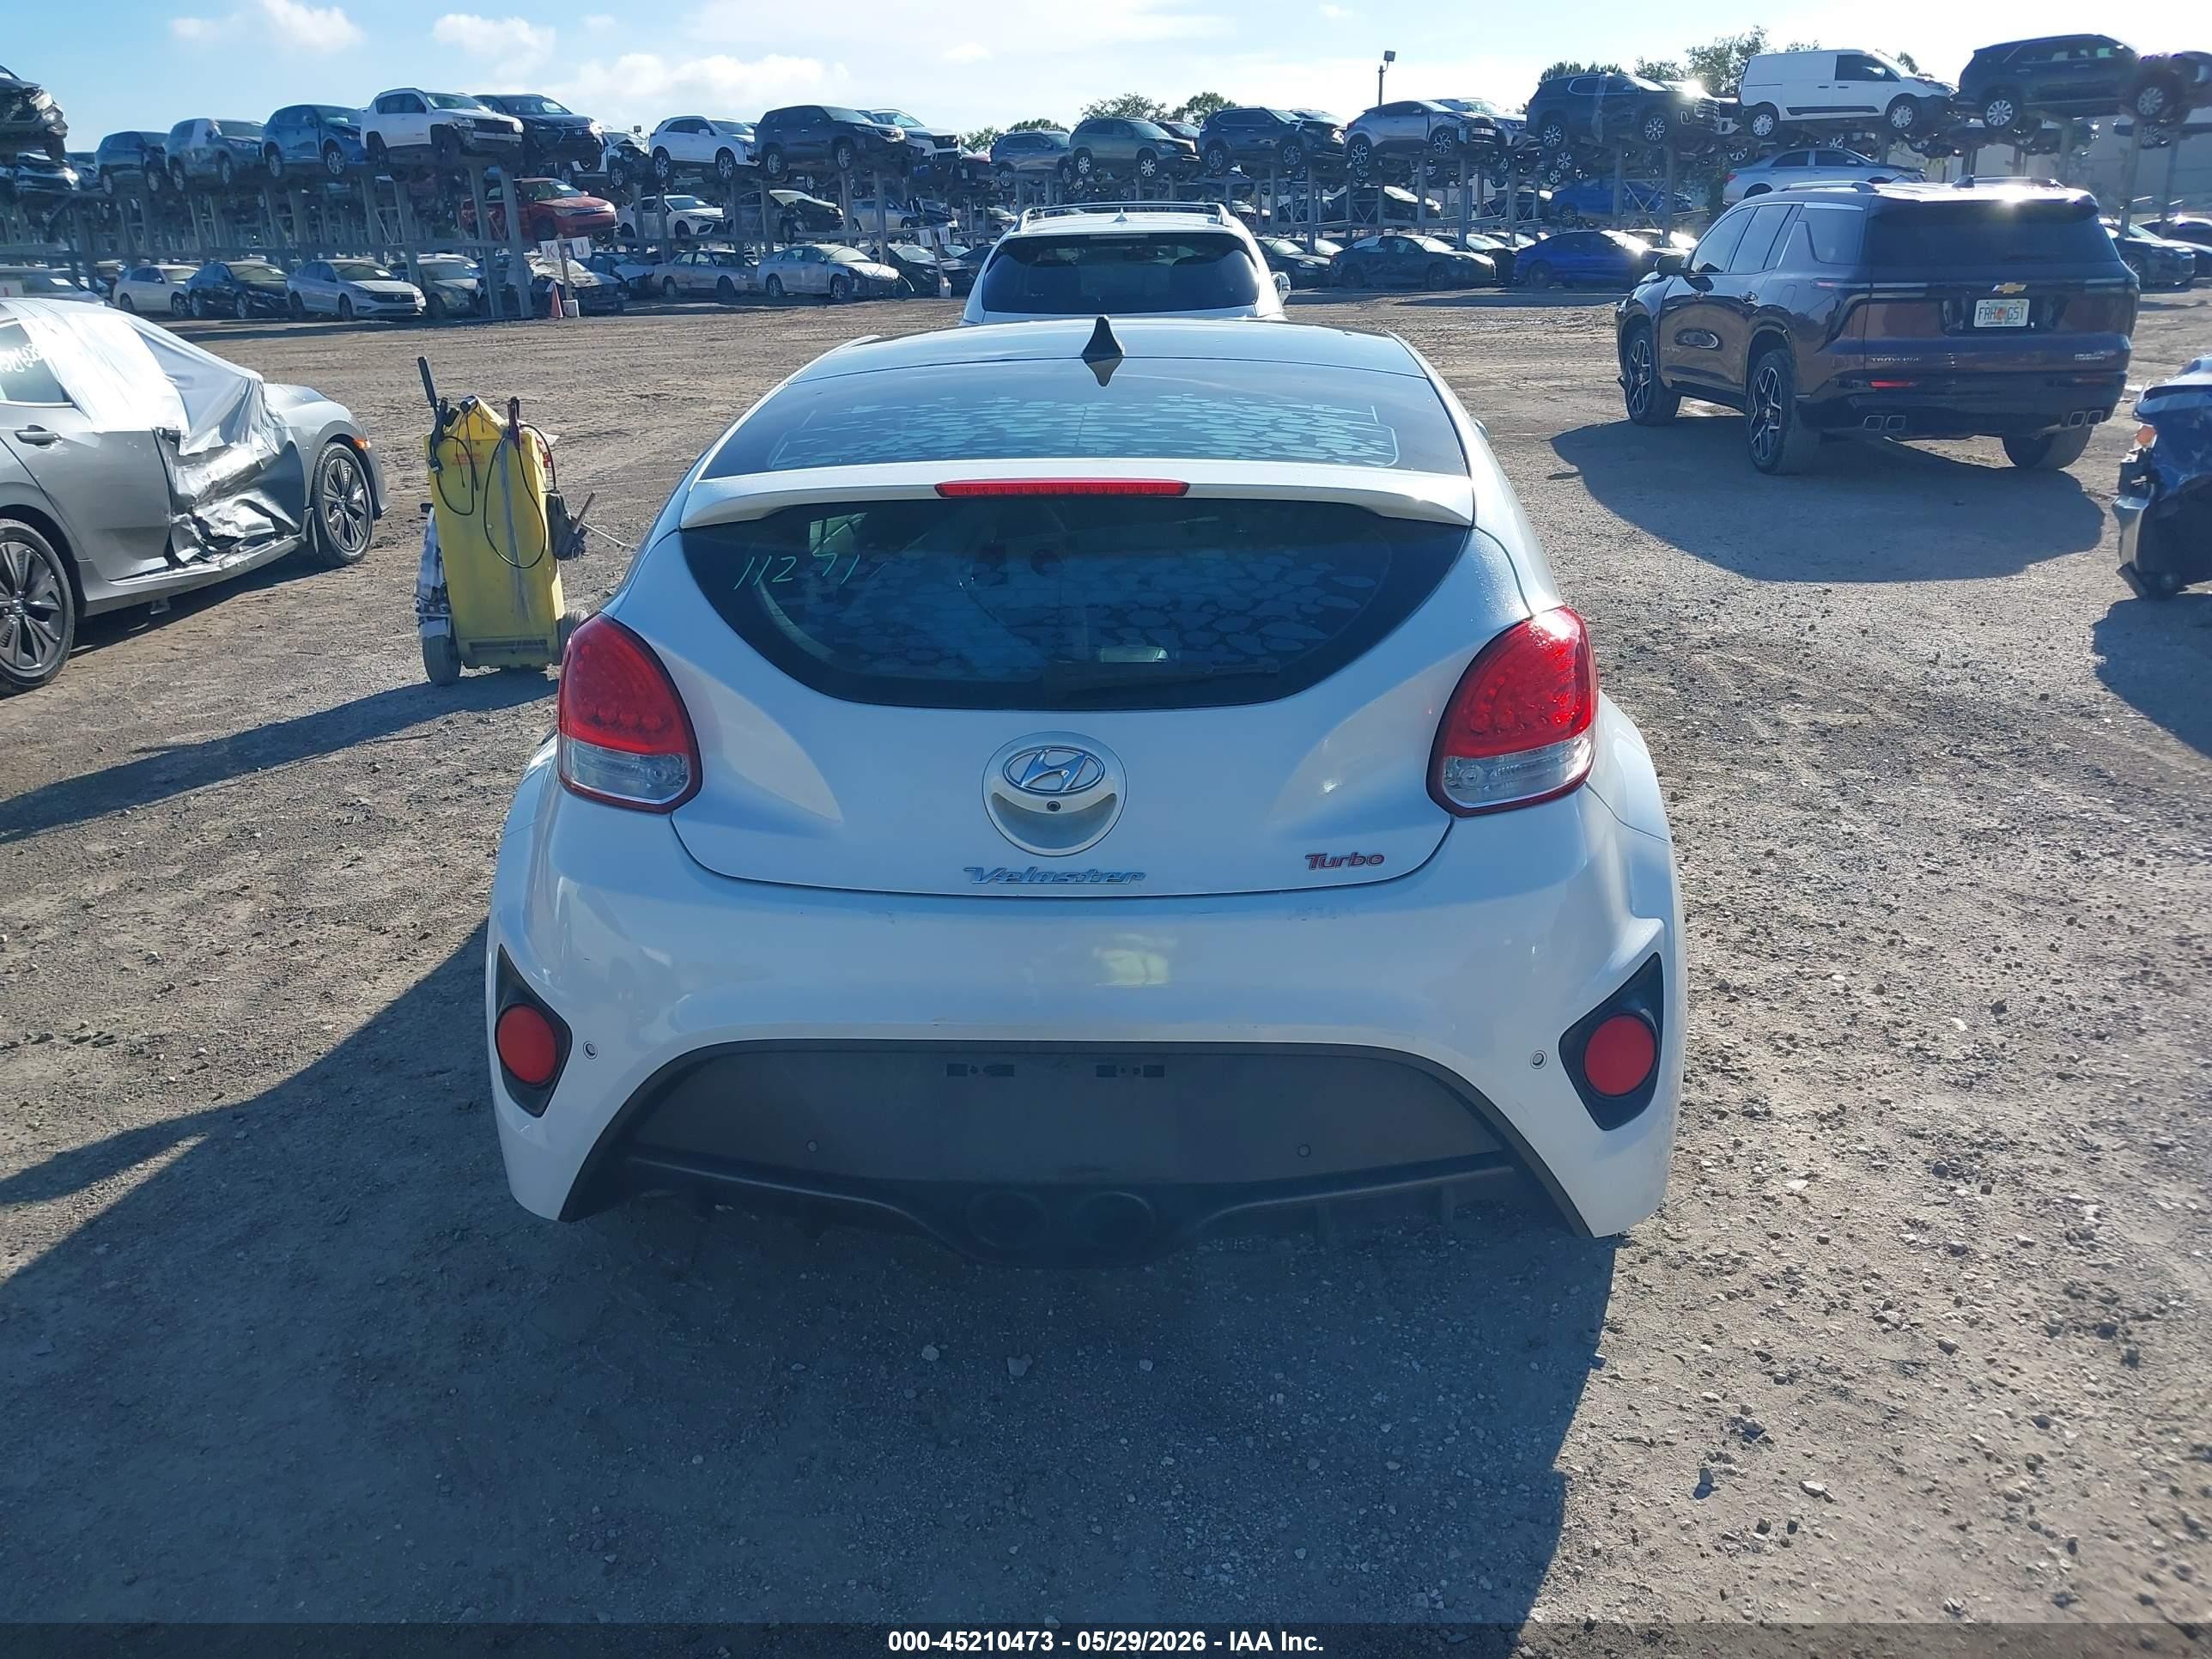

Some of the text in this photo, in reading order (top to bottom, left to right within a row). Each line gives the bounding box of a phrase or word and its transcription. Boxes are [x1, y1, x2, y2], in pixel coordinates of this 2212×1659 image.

[545, 244, 556, 258] K
[577, 242, 585, 255] J
[1304, 852, 1386, 871] Turbo
[963, 866, 1146, 884] Veloster
